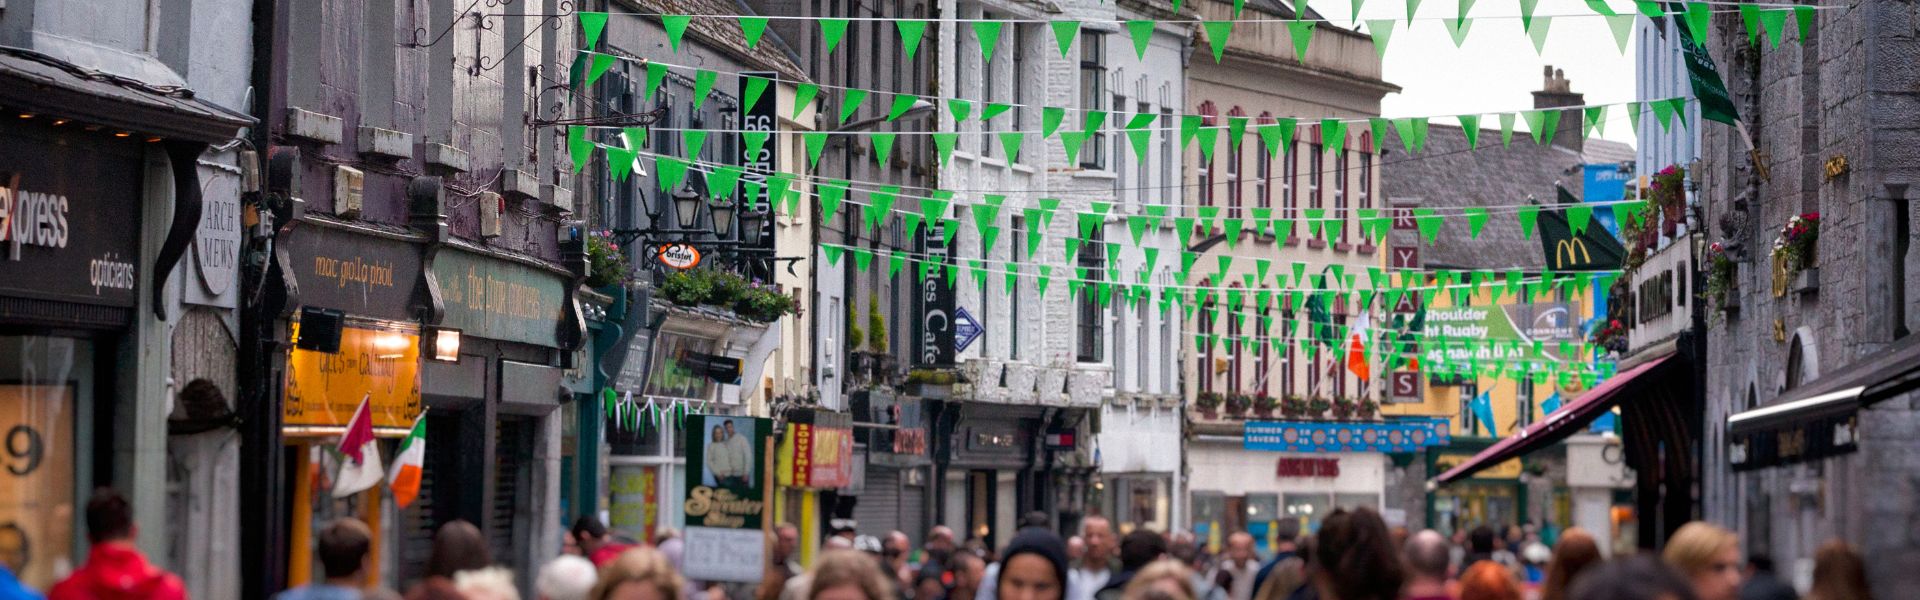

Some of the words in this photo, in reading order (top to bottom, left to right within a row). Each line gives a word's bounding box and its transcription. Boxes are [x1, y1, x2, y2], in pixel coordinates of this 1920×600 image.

[205, 200, 235, 232] ARCH
[203, 237, 234, 270] MEWS
[90, 251, 134, 295] opticians
[1397, 206, 1415, 394] RYAS
[925, 308, 949, 365] Cafe
[1442, 325, 1489, 339] Rugby
[1246, 426, 1282, 434] SUMMER
